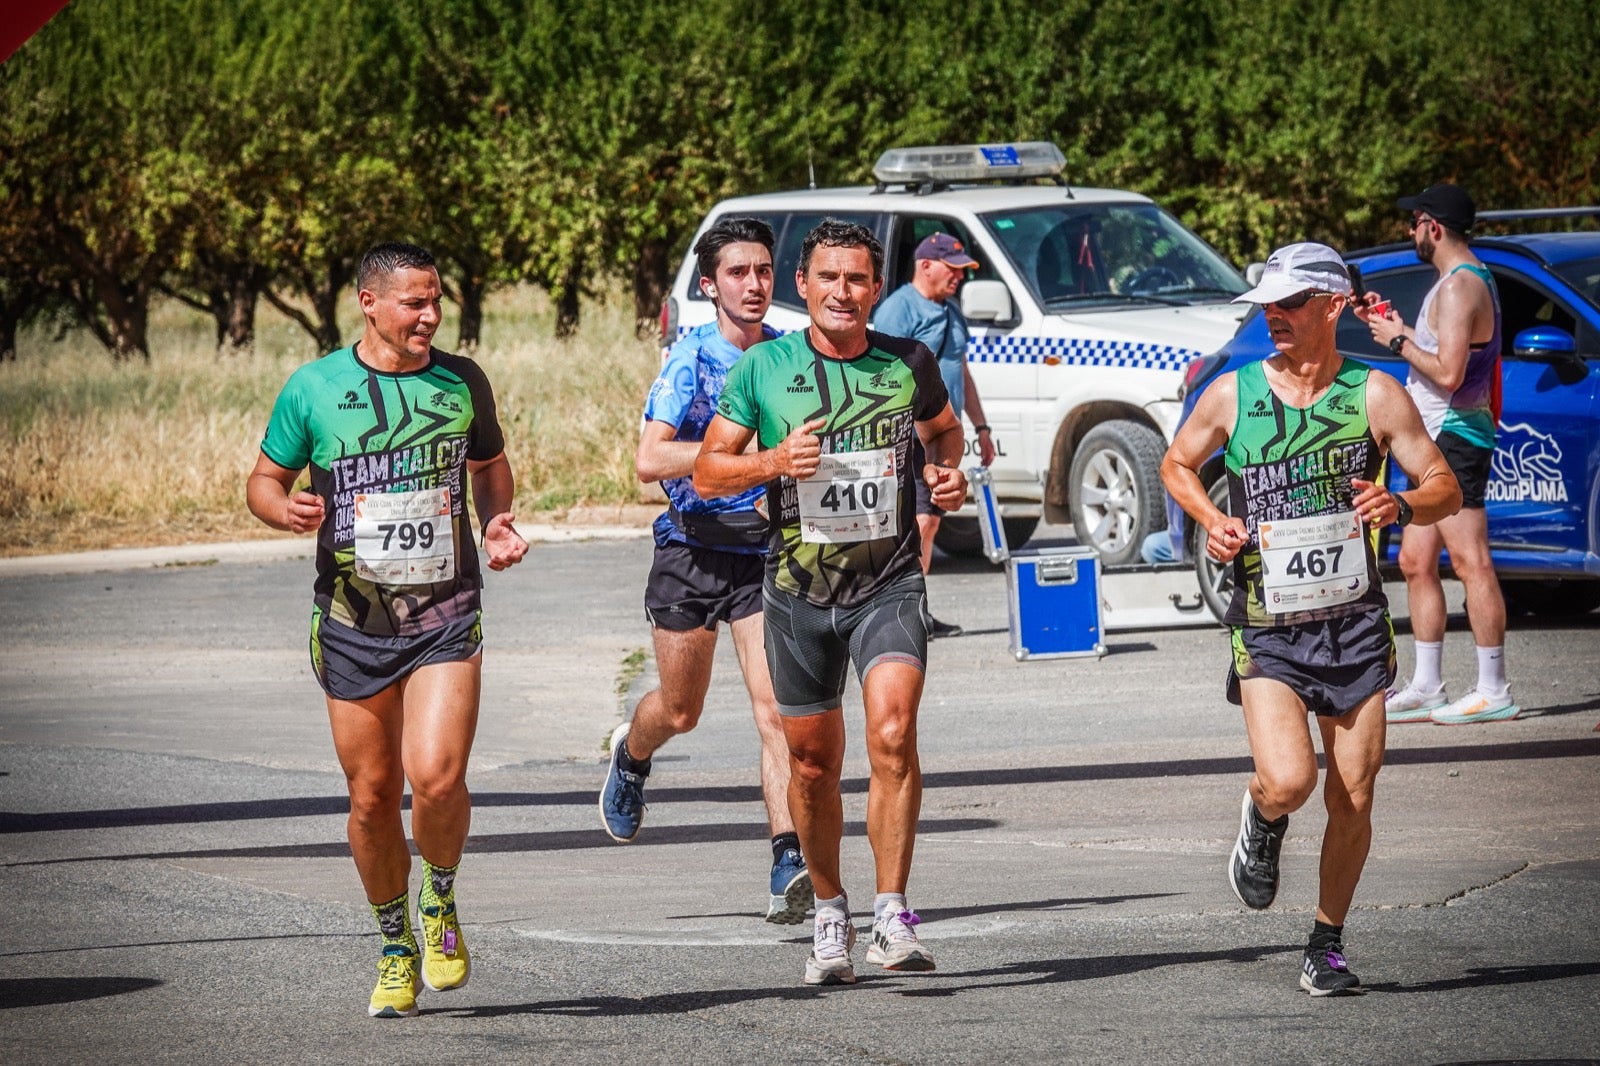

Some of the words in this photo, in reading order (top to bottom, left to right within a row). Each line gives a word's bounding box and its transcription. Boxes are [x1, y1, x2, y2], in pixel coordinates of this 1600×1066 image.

[964, 438, 1008, 456] OCL
[330, 454, 389, 492] TEAM
[1240, 462, 1288, 499] TEAM
[820, 482, 879, 512] 410
[1268, 490, 1286, 506] DE
[1287, 479, 1333, 500] MENTE
[377, 521, 435, 551] 799
[1286, 545, 1344, 579] 467
